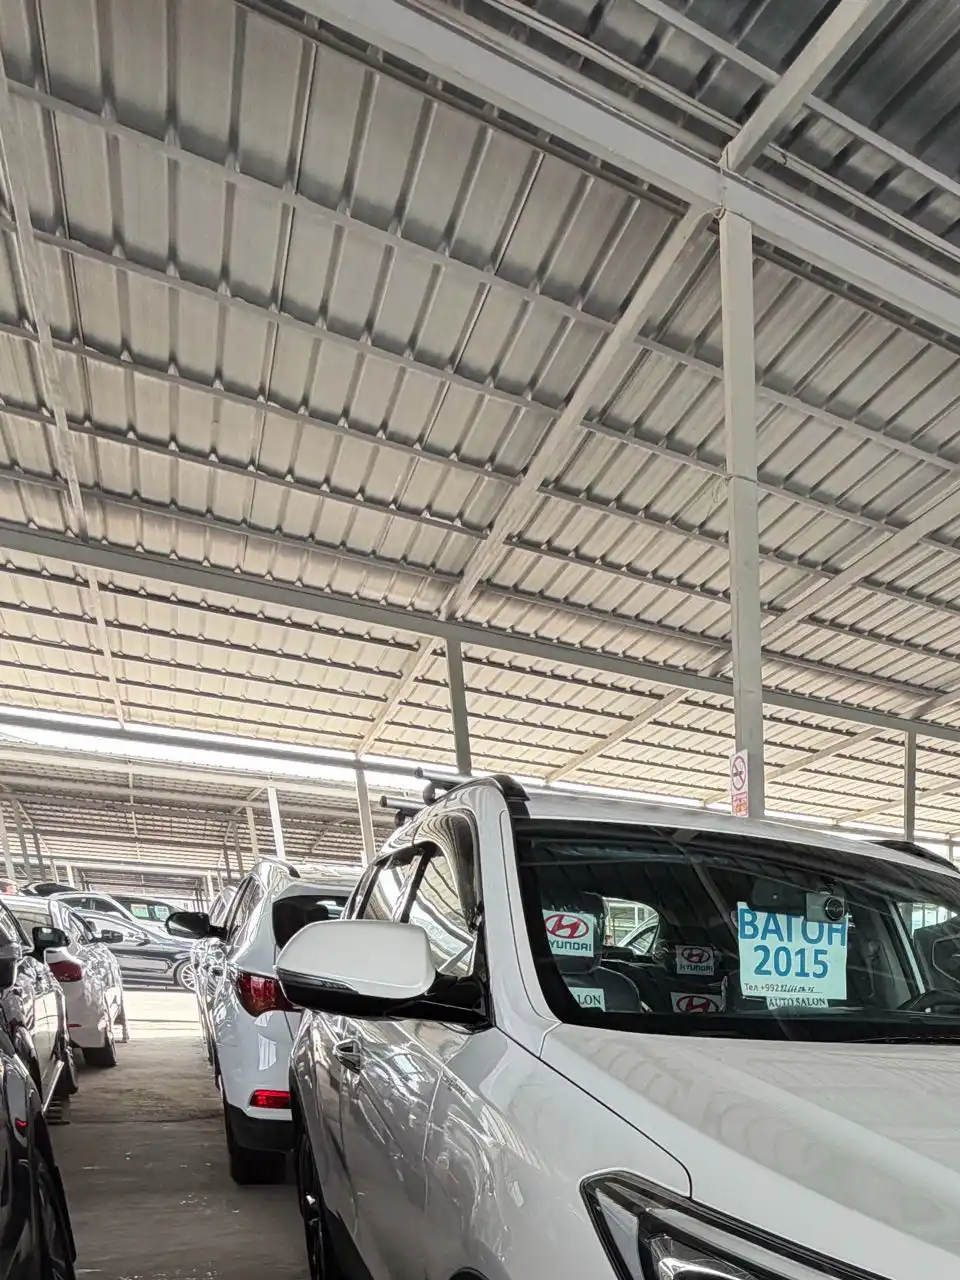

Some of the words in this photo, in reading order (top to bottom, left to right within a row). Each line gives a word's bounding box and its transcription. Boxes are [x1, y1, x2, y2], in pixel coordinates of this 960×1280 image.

[740, 908, 846, 947] ВАГОН
[549, 939, 592, 952] YUNDAI
[754, 944, 829, 978] 2015
[576, 994, 602, 1006] LON
